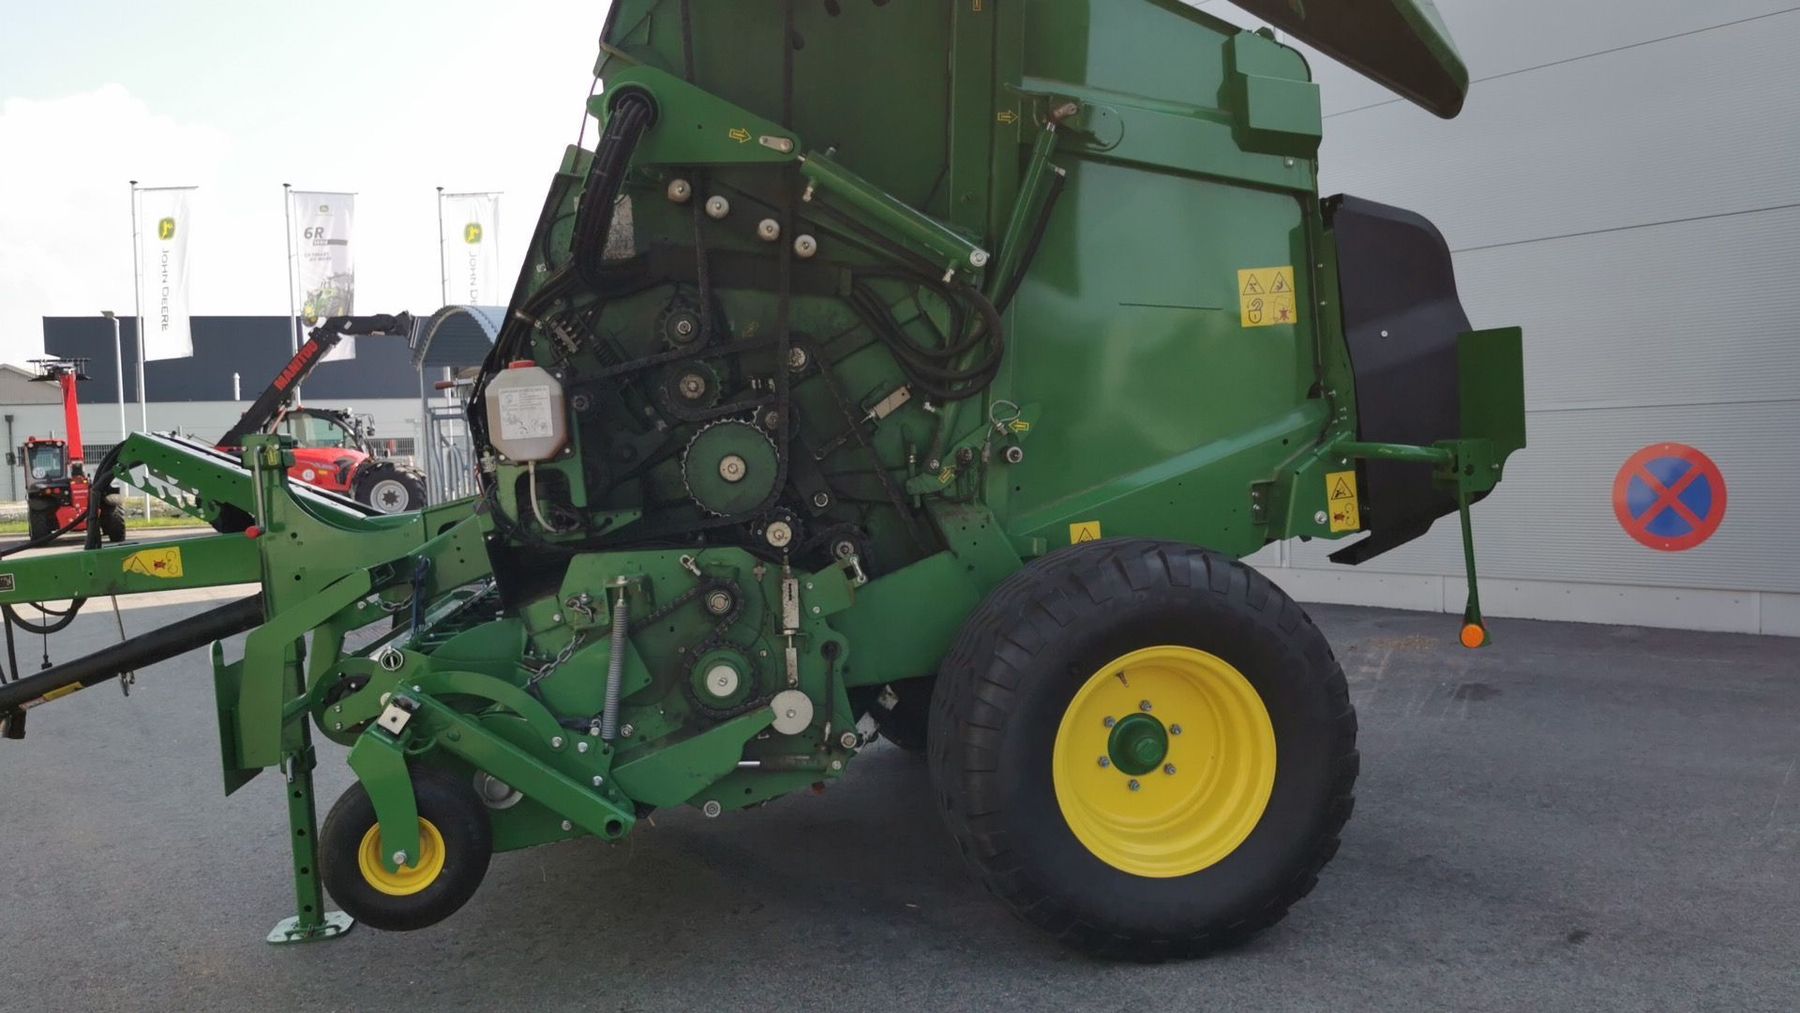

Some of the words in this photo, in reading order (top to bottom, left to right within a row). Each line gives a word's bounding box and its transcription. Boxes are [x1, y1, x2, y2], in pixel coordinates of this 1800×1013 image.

[304, 226, 324, 240] 6R
[161, 248, 170, 284] JOHN
[161, 286, 170, 332] DEERE
[273, 339, 318, 391] MANITOU
